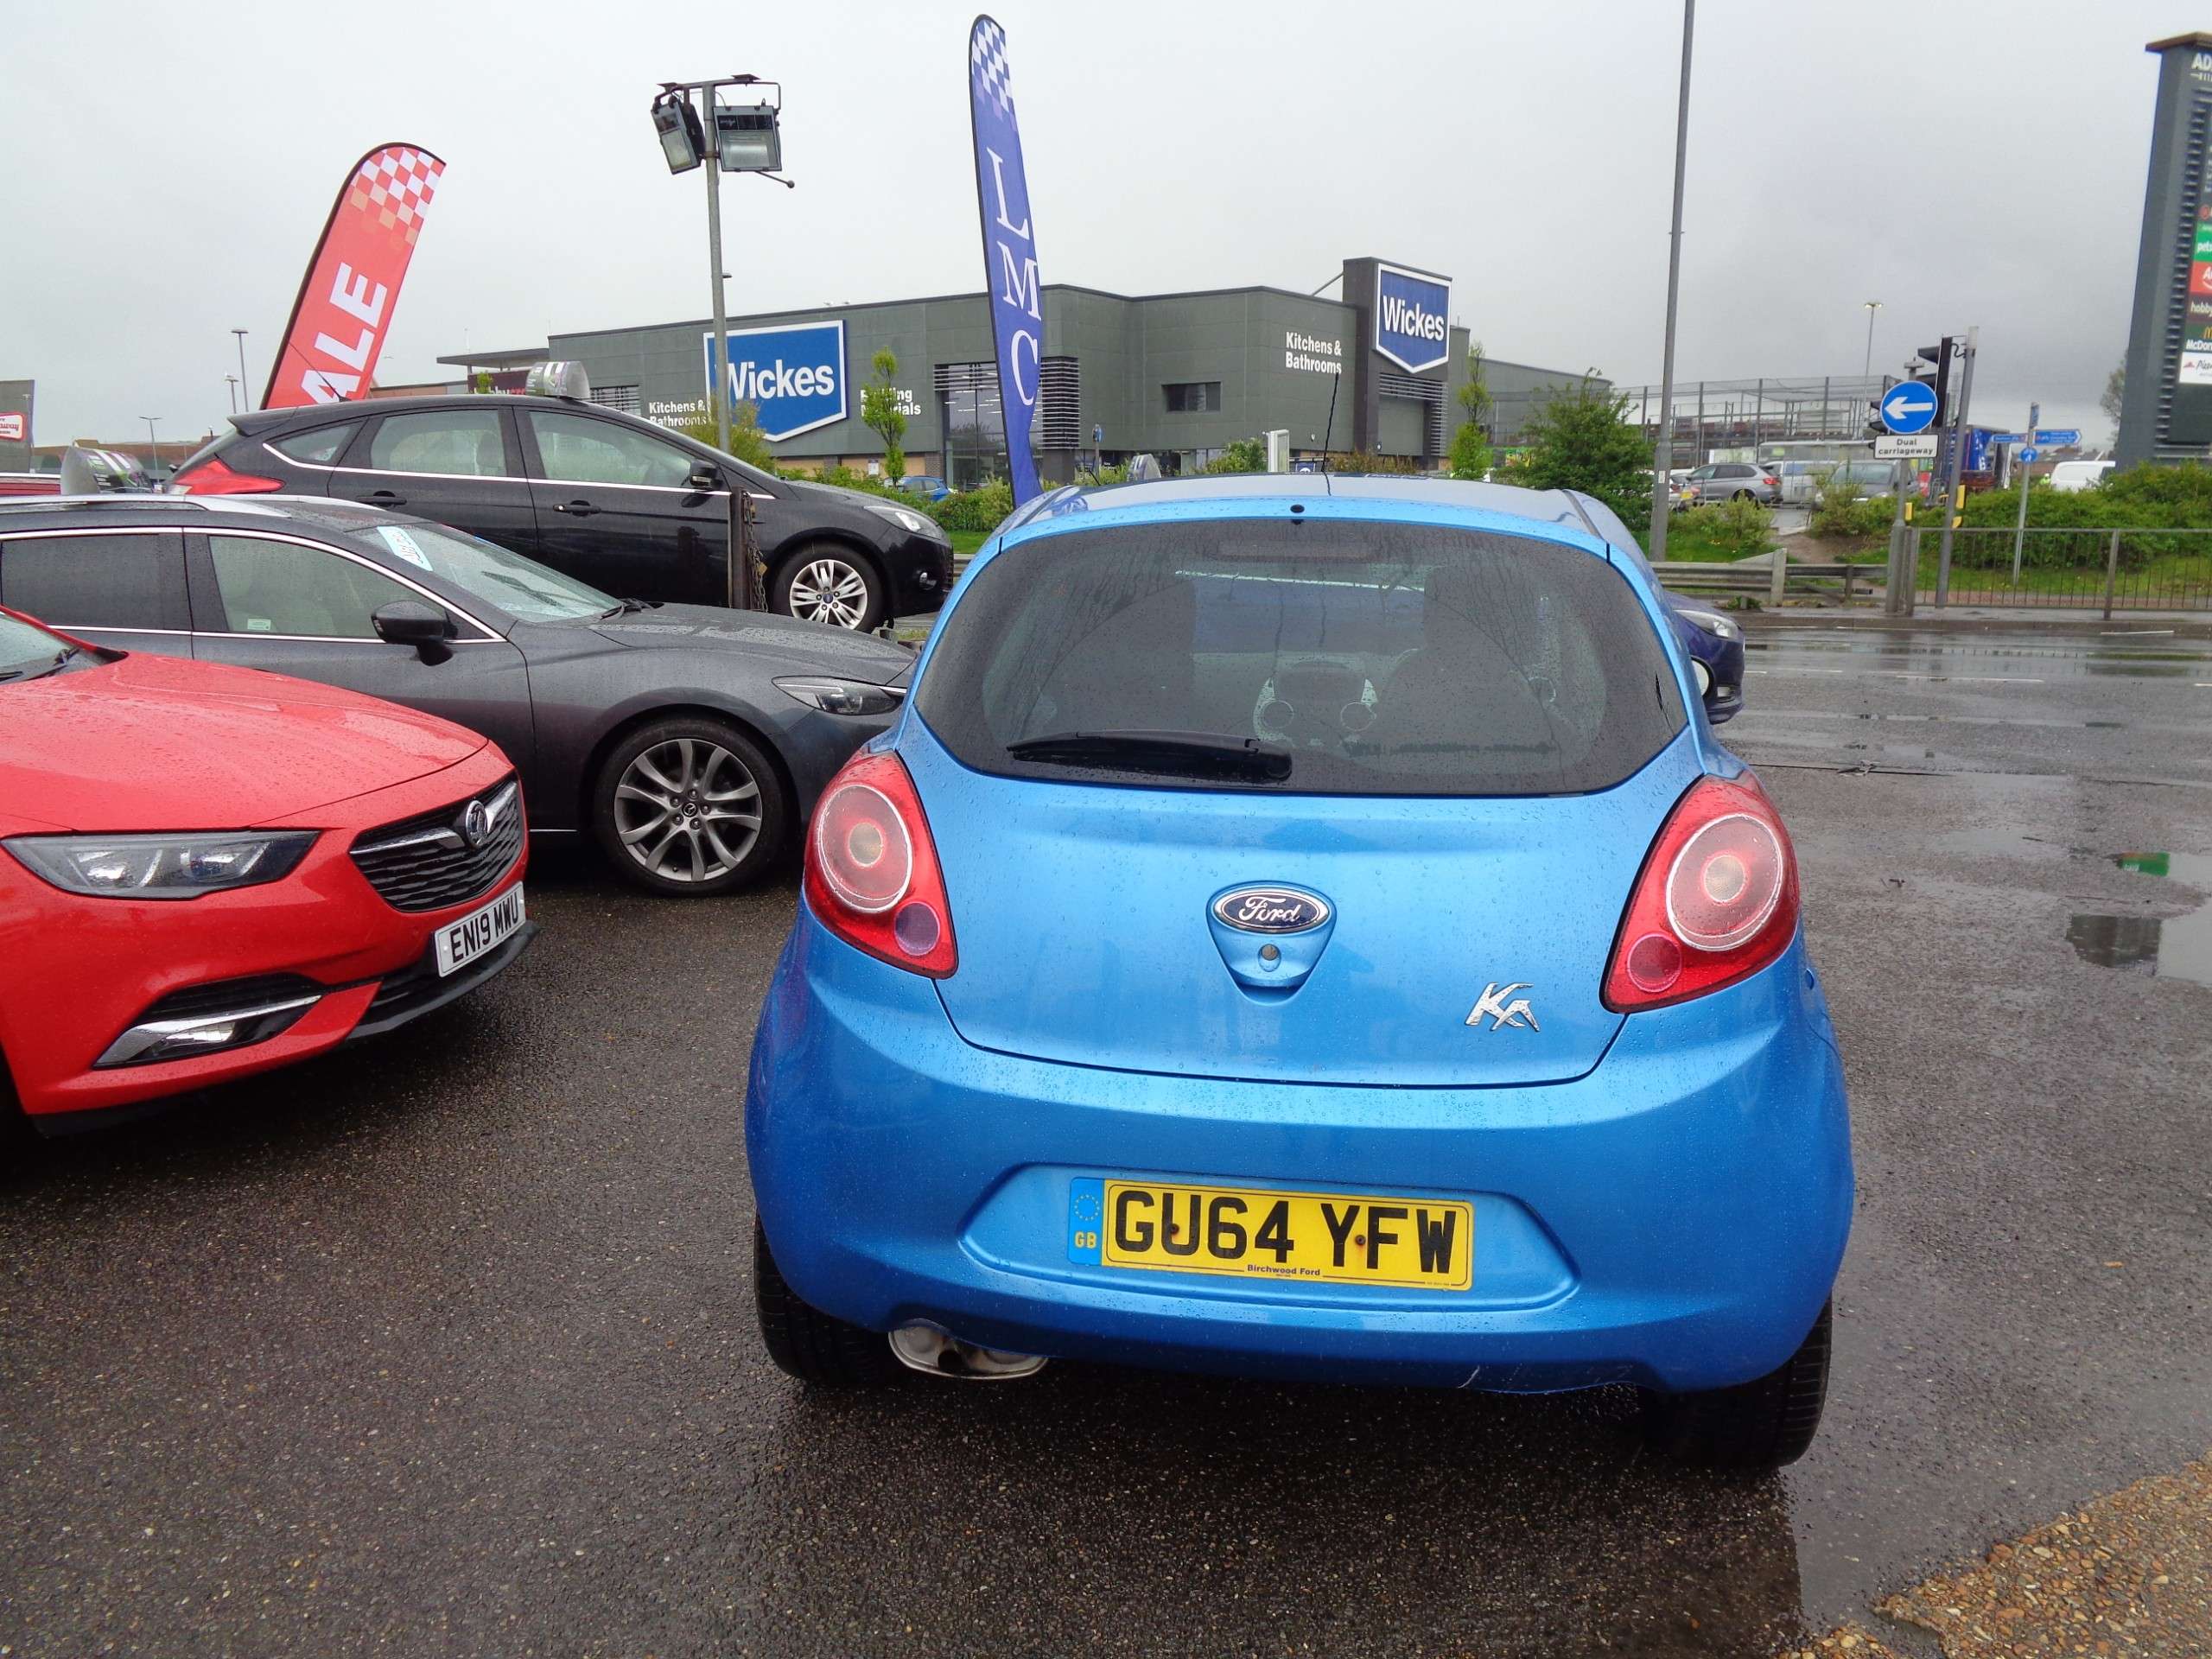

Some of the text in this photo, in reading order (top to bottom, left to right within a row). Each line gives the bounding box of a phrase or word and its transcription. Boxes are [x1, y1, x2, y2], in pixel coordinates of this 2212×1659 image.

[1382, 295, 1445, 341] Wickes
[1286, 332, 1342, 356] Kitchens &
[1285, 351, 1342, 373] Bathrooms
[649, 399, 706, 414] Kitchens &
[1878, 447, 1934, 455] carriageway
[1896, 437, 1917, 446] Dual
[1237, 895, 1300, 923] Ford
[450, 891, 519, 963] EN19 MWU
[1074, 1231, 1097, 1249] GB
[1115, 1189, 1457, 1274] GU64 YFW
[1247, 1264, 1297, 1274] Birchwood
[1299, 1267, 1321, 1277] Ford
